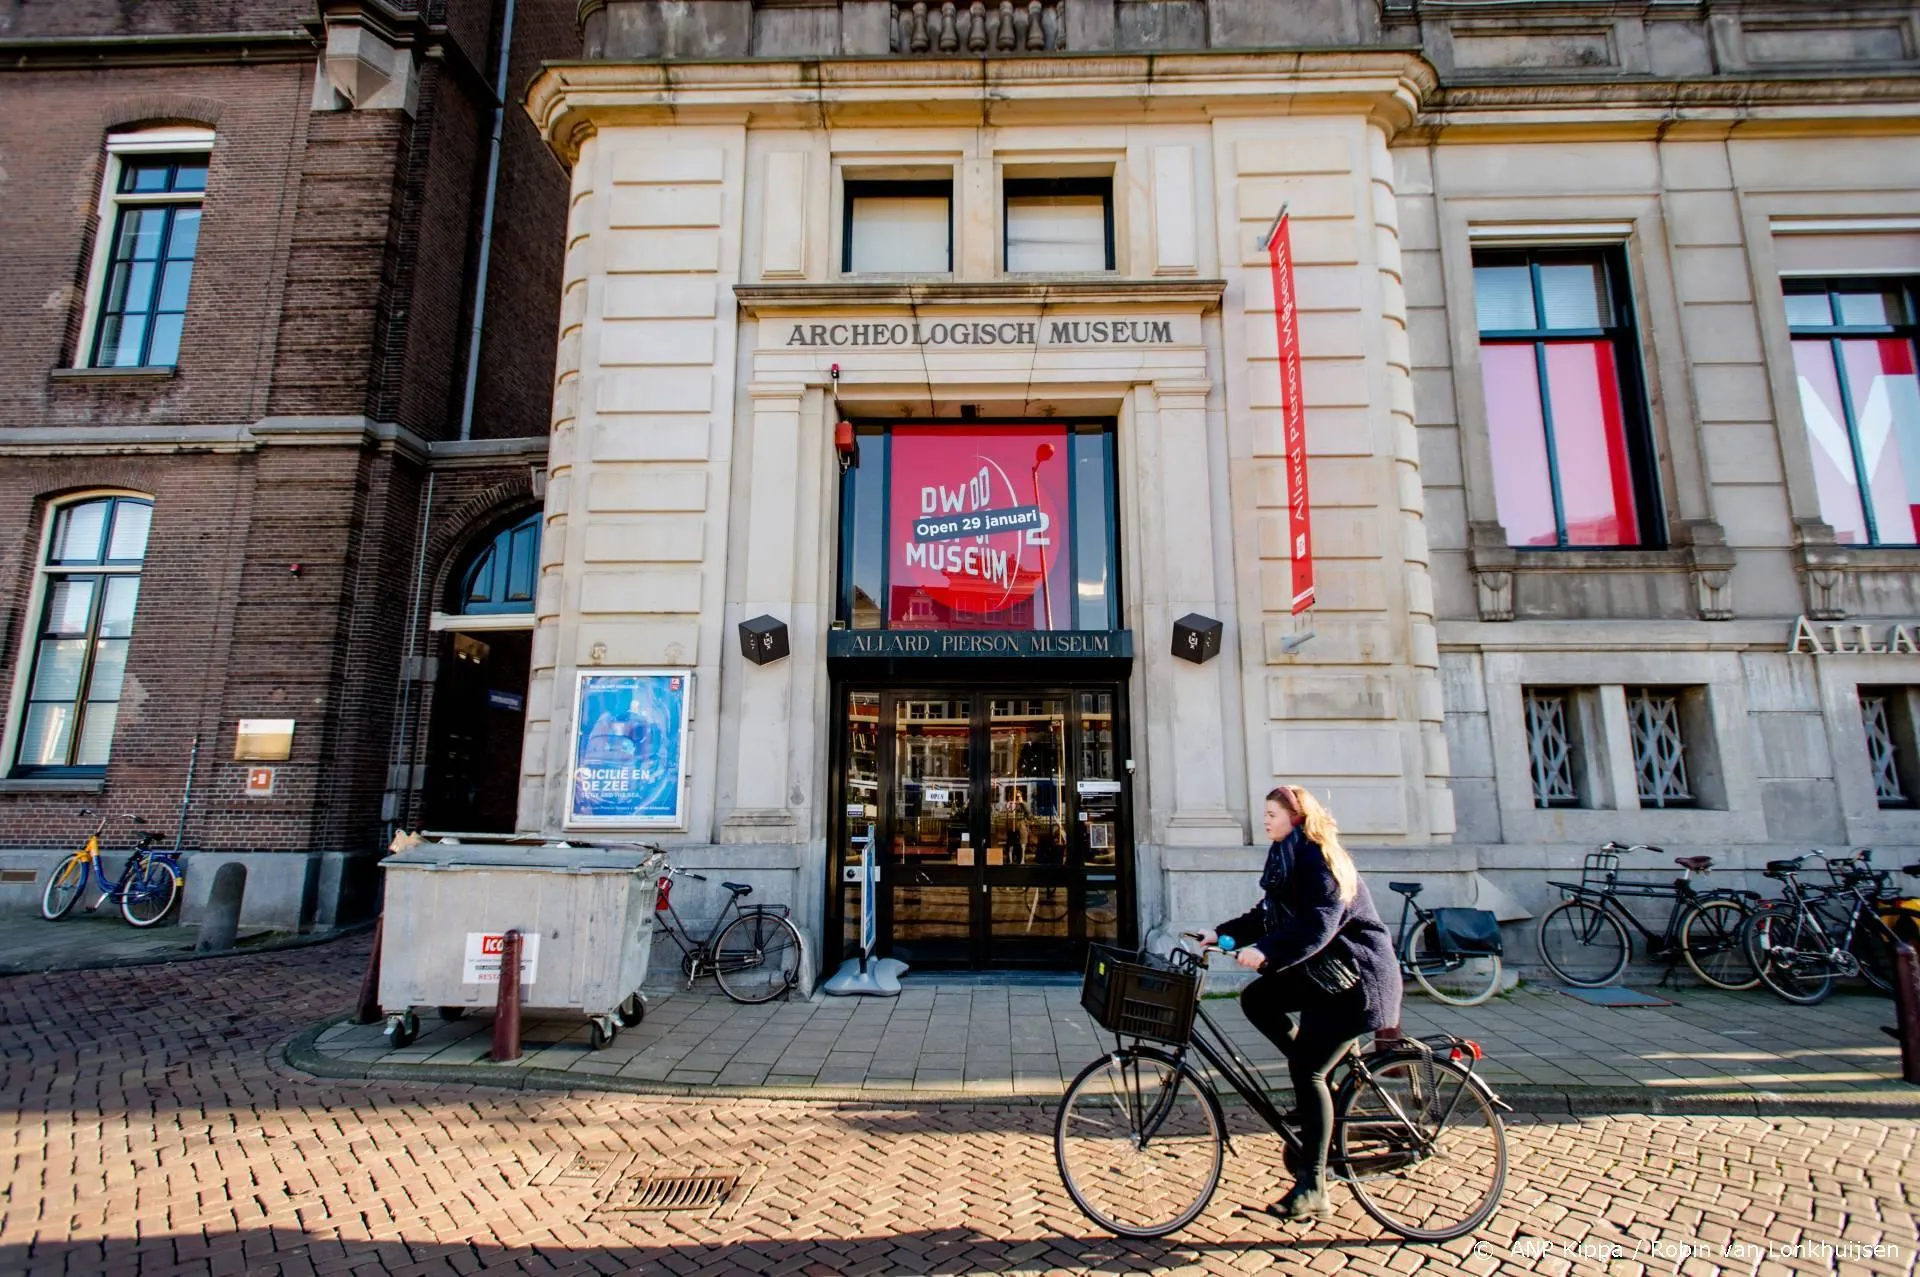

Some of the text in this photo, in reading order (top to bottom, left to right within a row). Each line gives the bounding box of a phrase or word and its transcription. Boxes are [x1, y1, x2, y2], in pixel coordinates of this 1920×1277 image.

[786, 320, 1174, 346] ARCHEOLOGISCH MUSEUM
[1287, 351, 1300, 444] Pierson
[921, 466, 991, 513] DWDD
[1290, 446, 1305, 521] Allard
[916, 509, 1038, 537] Open 29 januari
[1025, 512, 1051, 546] 2
[905, 541, 1009, 589] MUSEUM
[851, 635, 1110, 652] ALLARD PIERSON MUSEUM
[1787, 614, 1920, 655] ALLA
[582, 780, 629, 792] DE ZEE
[632, 769, 651, 780] EN
